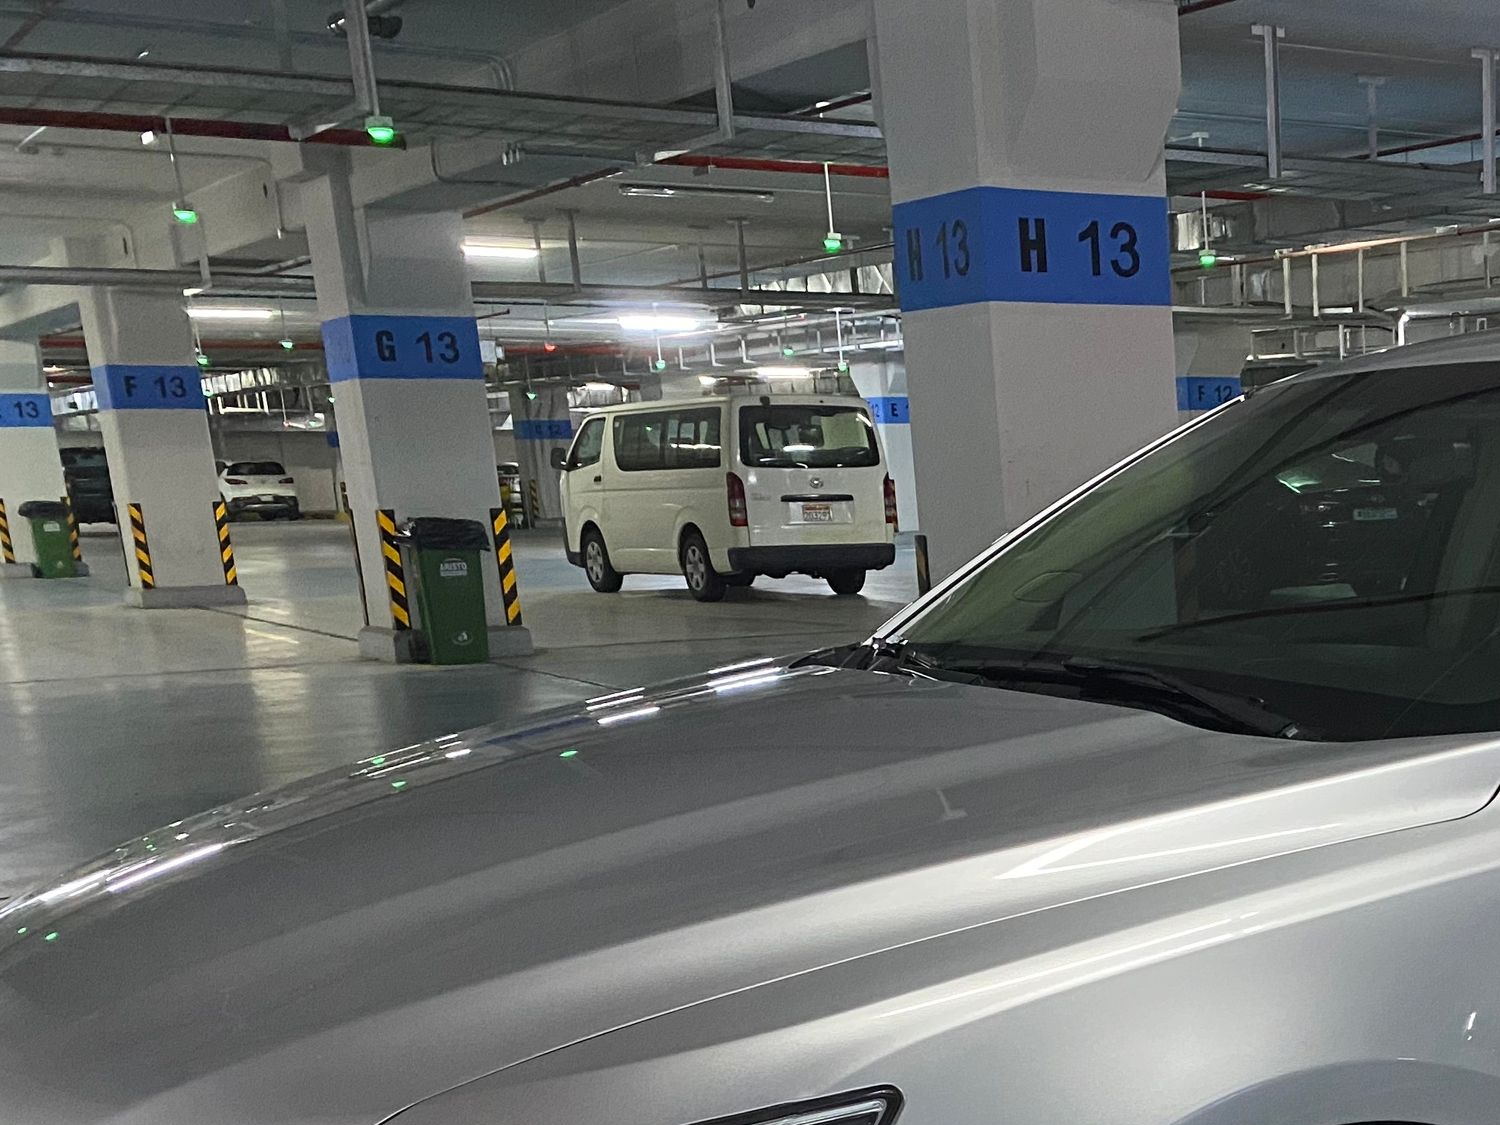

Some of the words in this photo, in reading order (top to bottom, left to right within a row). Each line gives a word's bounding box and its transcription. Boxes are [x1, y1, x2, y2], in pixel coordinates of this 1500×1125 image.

[906, 228, 923, 281] H
[936, 219, 970, 279] 13
[1018, 217, 1048, 273] H
[1078, 220, 1141, 278] 13
[375, 330, 397, 362] G
[415, 331, 460, 363] 13
[124, 376, 138, 397] F
[154, 376, 187, 398] 13
[1214, 385, 1233, 402] 12
[13, 401, 39, 418] 13
[891, 403, 899, 417] E
